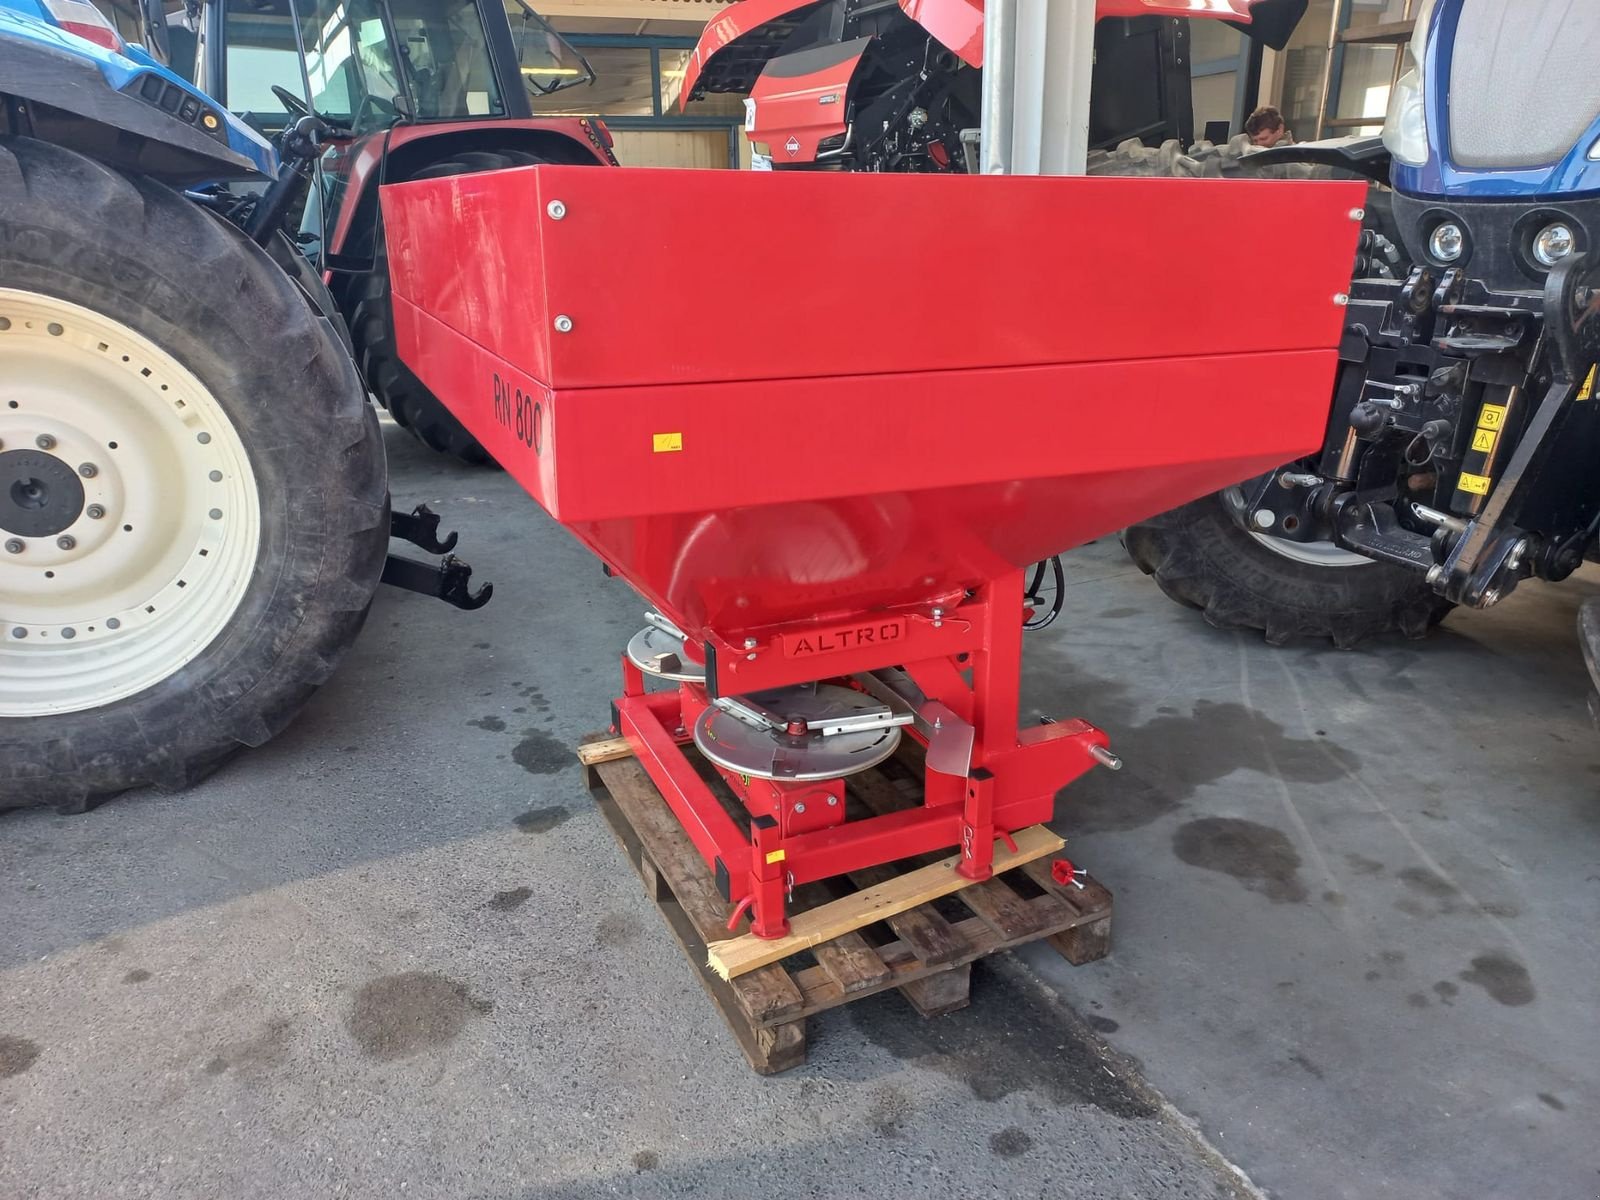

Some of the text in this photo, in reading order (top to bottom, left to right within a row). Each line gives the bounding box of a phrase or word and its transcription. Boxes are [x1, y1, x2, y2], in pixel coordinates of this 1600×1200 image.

[493, 373, 543, 456] RN 800
[793, 623, 900, 655] ALTRO
